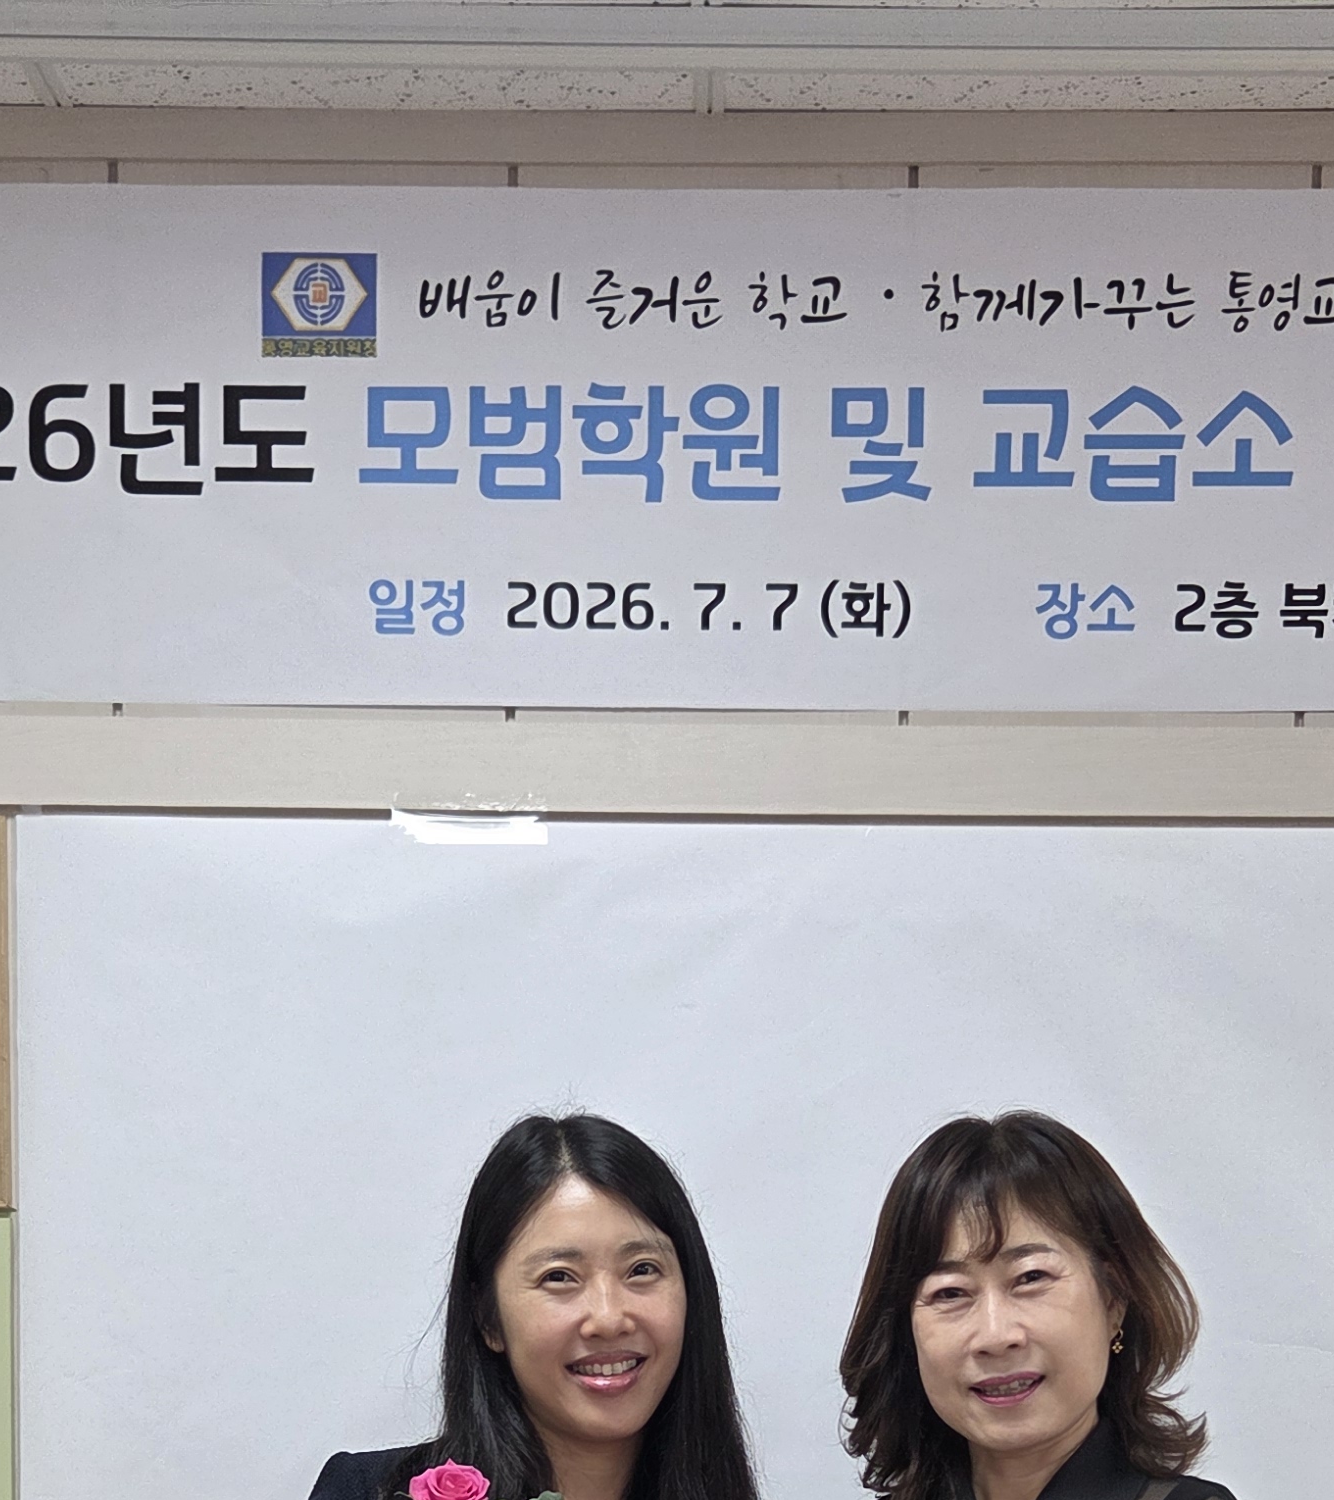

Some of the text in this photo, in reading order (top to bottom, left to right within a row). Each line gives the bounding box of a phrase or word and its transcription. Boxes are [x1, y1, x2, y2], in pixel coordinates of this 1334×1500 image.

[418, 269, 560, 328] 배움이
[586, 270, 724, 329] 즐거운
[748, 271, 848, 330] 학교
[920, 271, 1196, 333] 함께가꾸는
[358, 382, 782, 504] 모범학원
[830, 385, 932, 504] 및
[973, 385, 1294, 502] 교습소
[368, 578, 466, 636] 일정
[505, 581, 670, 631] 2026.
[692, 582, 743, 632] 7.
[765, 582, 799, 632] 7
[819, 578, 912, 639] (화)
[1034, 582, 1137, 640] 장소
[1173, 580, 1260, 639] 2층
